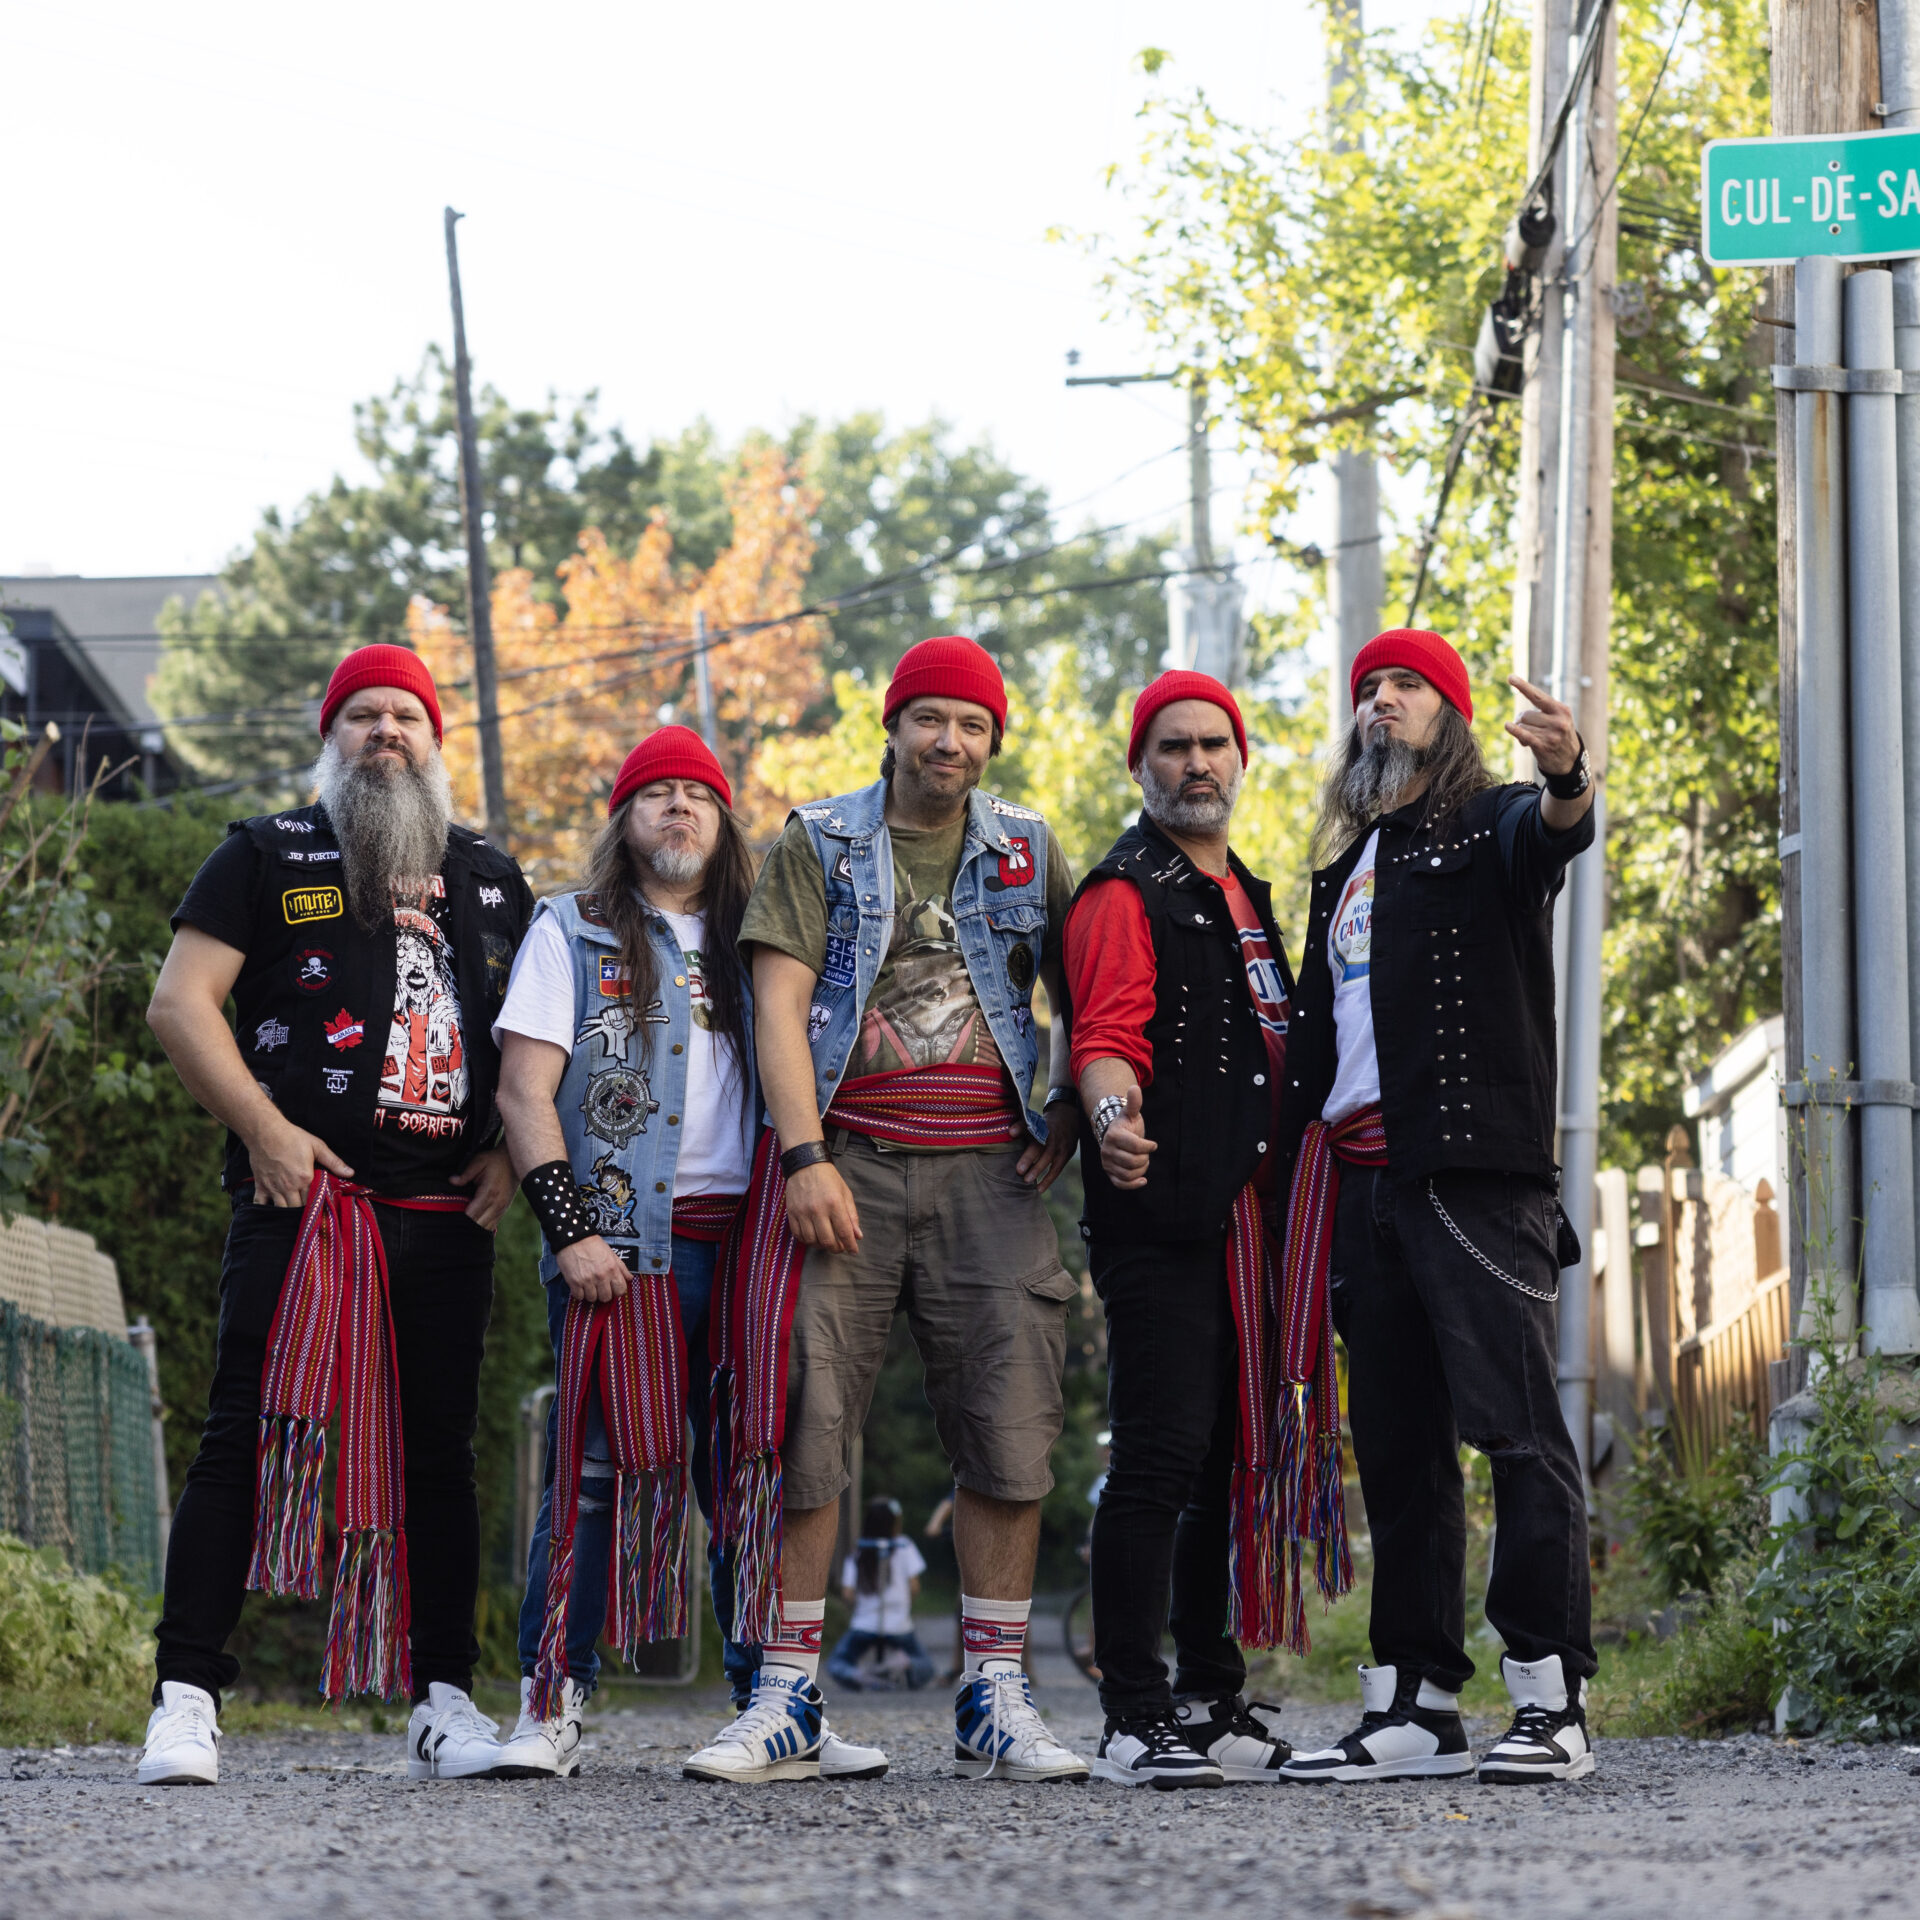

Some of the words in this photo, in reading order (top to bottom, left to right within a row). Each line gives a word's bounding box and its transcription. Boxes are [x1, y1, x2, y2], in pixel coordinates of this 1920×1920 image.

[307, 851, 340, 862] FORTIN
[332, 1026, 358, 1042] CANADA
[760, 1674, 796, 1691] didas
